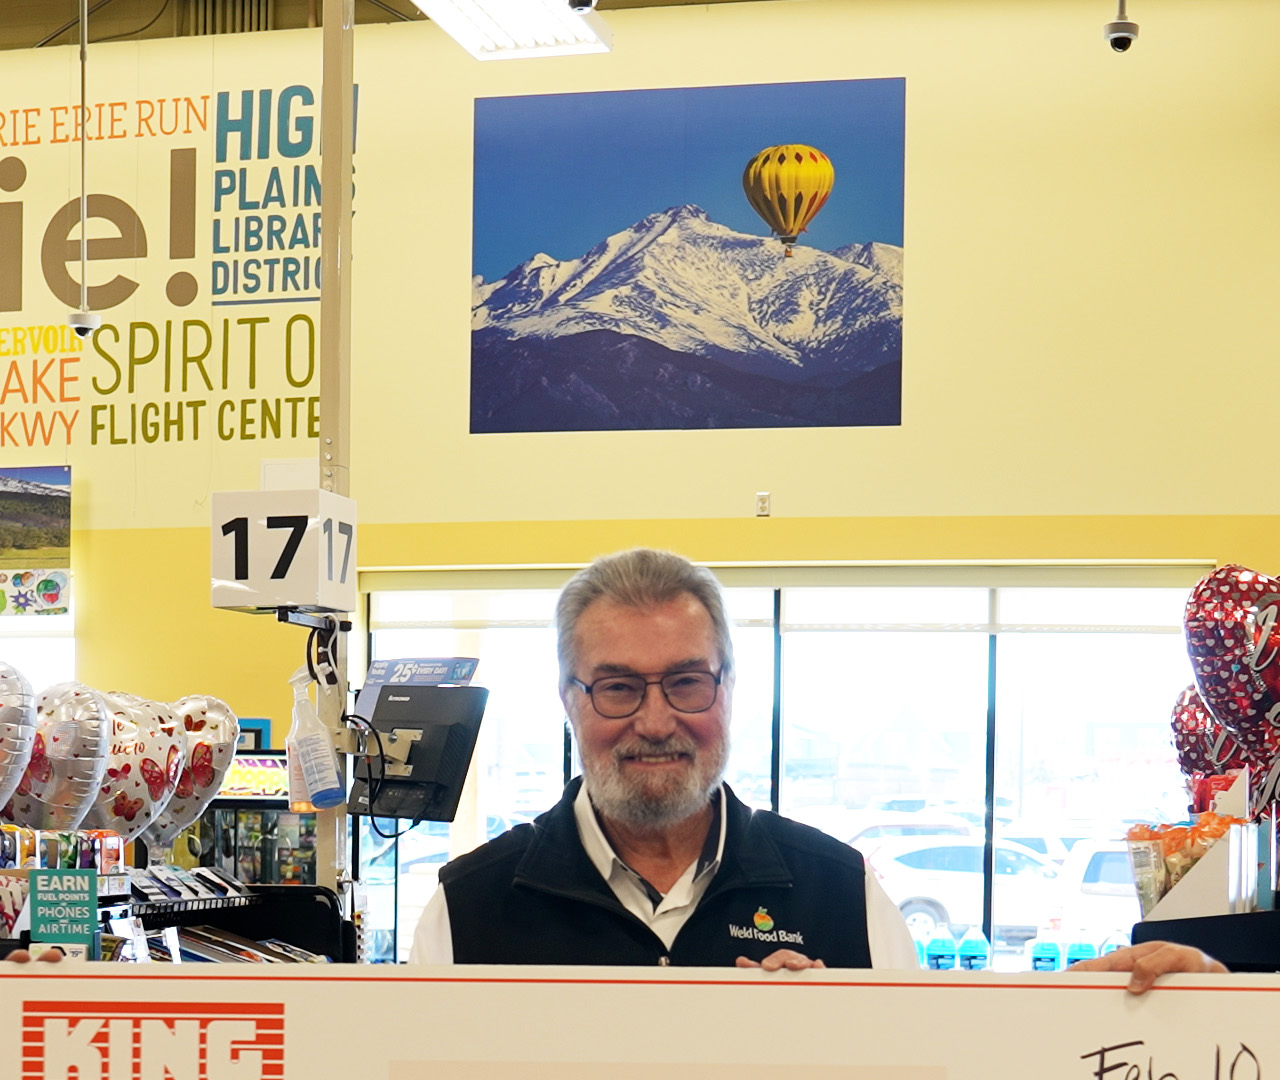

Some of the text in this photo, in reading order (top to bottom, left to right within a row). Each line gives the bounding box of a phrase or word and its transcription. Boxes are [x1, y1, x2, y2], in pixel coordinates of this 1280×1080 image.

[50, 101, 128, 145] ERIE
[136, 95, 210, 137] RUN
[216, 84, 359, 162] HIG
[214, 164, 356, 212] PLAIN
[212, 255, 323, 296] DISTRI
[91, 317, 271, 395] SPIRIT
[90, 396, 321, 446] FLIGHT CENTE
[221, 515, 309, 581] 17
[322, 517, 353, 584] 17
[37, 875, 90, 892] EARN
[37, 892, 90, 902] FUEL POINTS
[37, 906, 90, 919] PHONES
[38, 923, 90, 935] AIRTIME
[729, 923, 804, 945] Weld Food Bank
